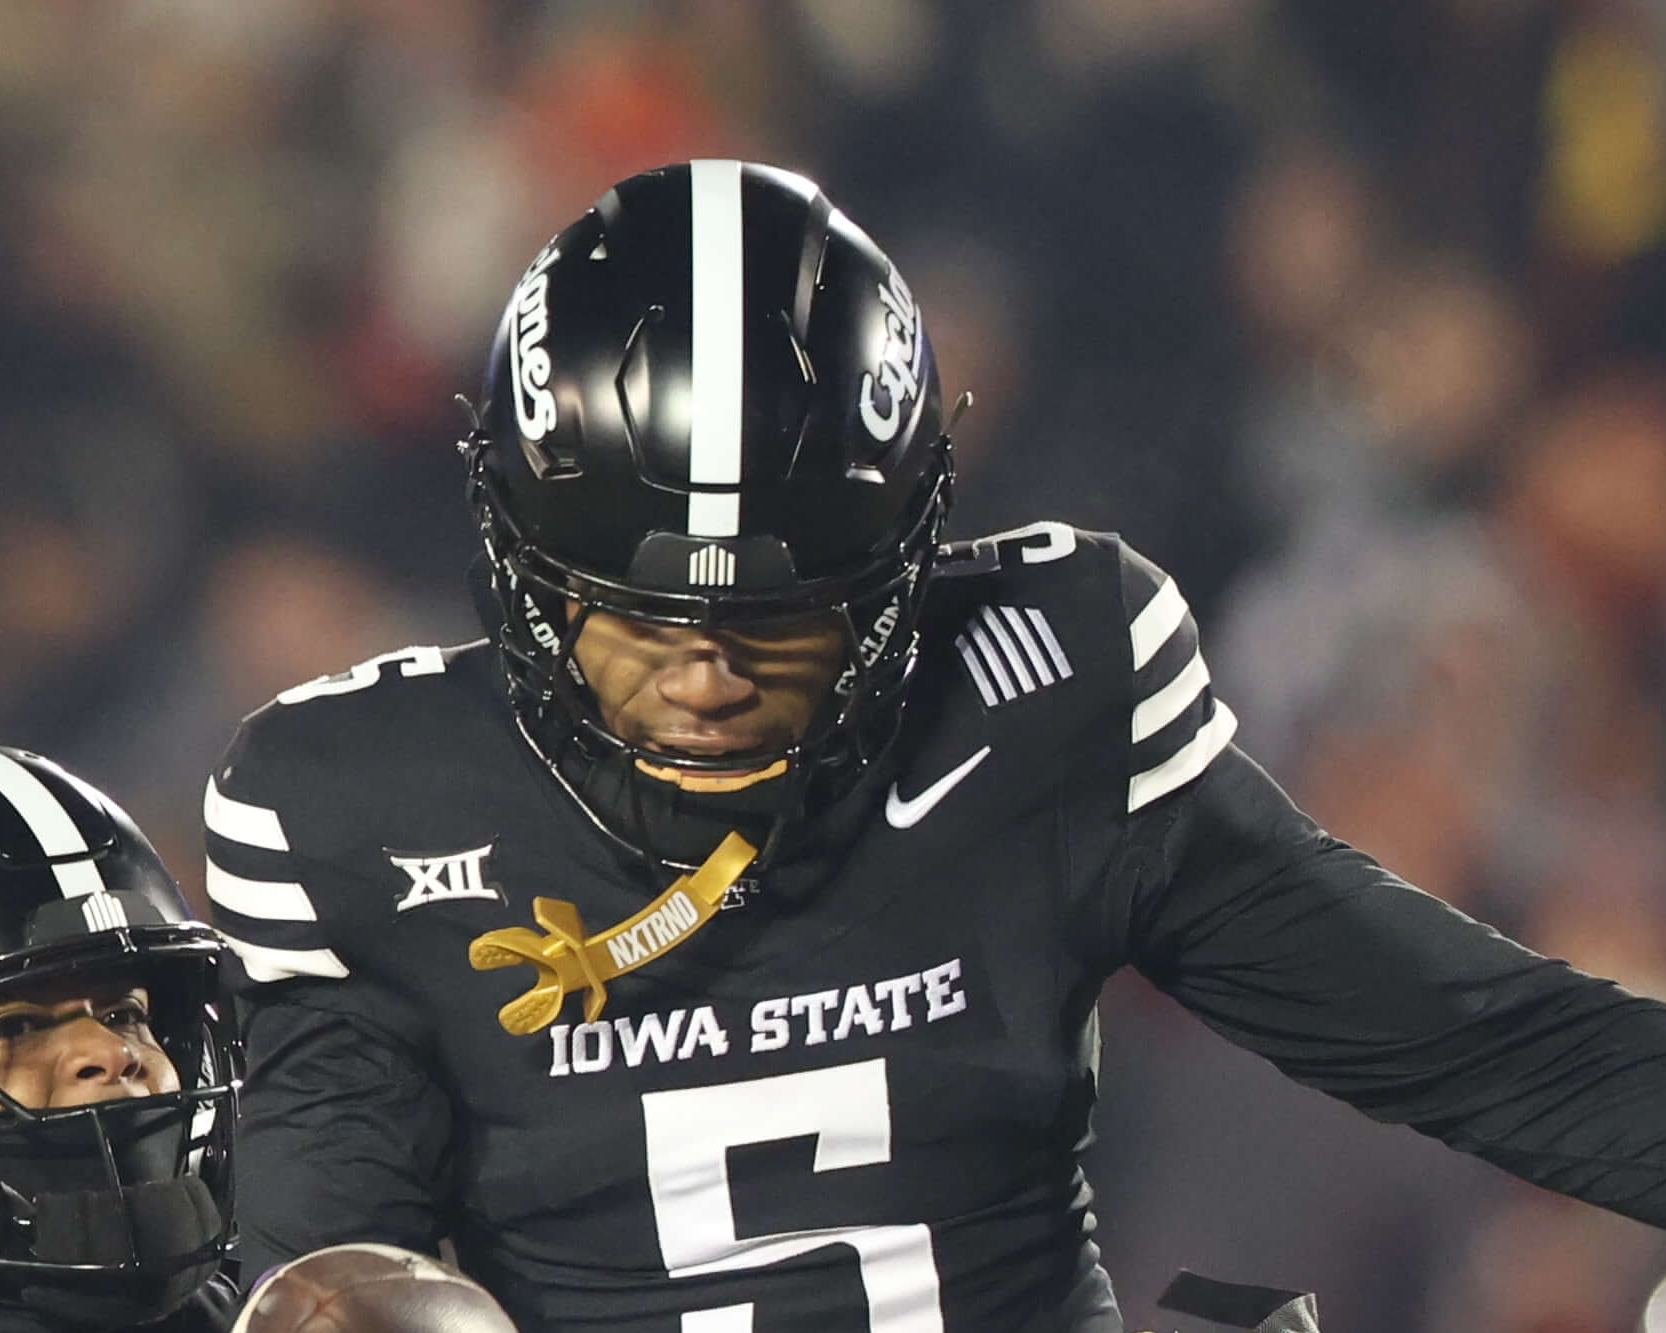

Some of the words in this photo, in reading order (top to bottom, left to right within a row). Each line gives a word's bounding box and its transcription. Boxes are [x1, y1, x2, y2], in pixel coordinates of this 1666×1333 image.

[606, 890, 699, 970] NXTRND
[548, 1005, 731, 1078] IOWA
[749, 957, 968, 1054] STATE
